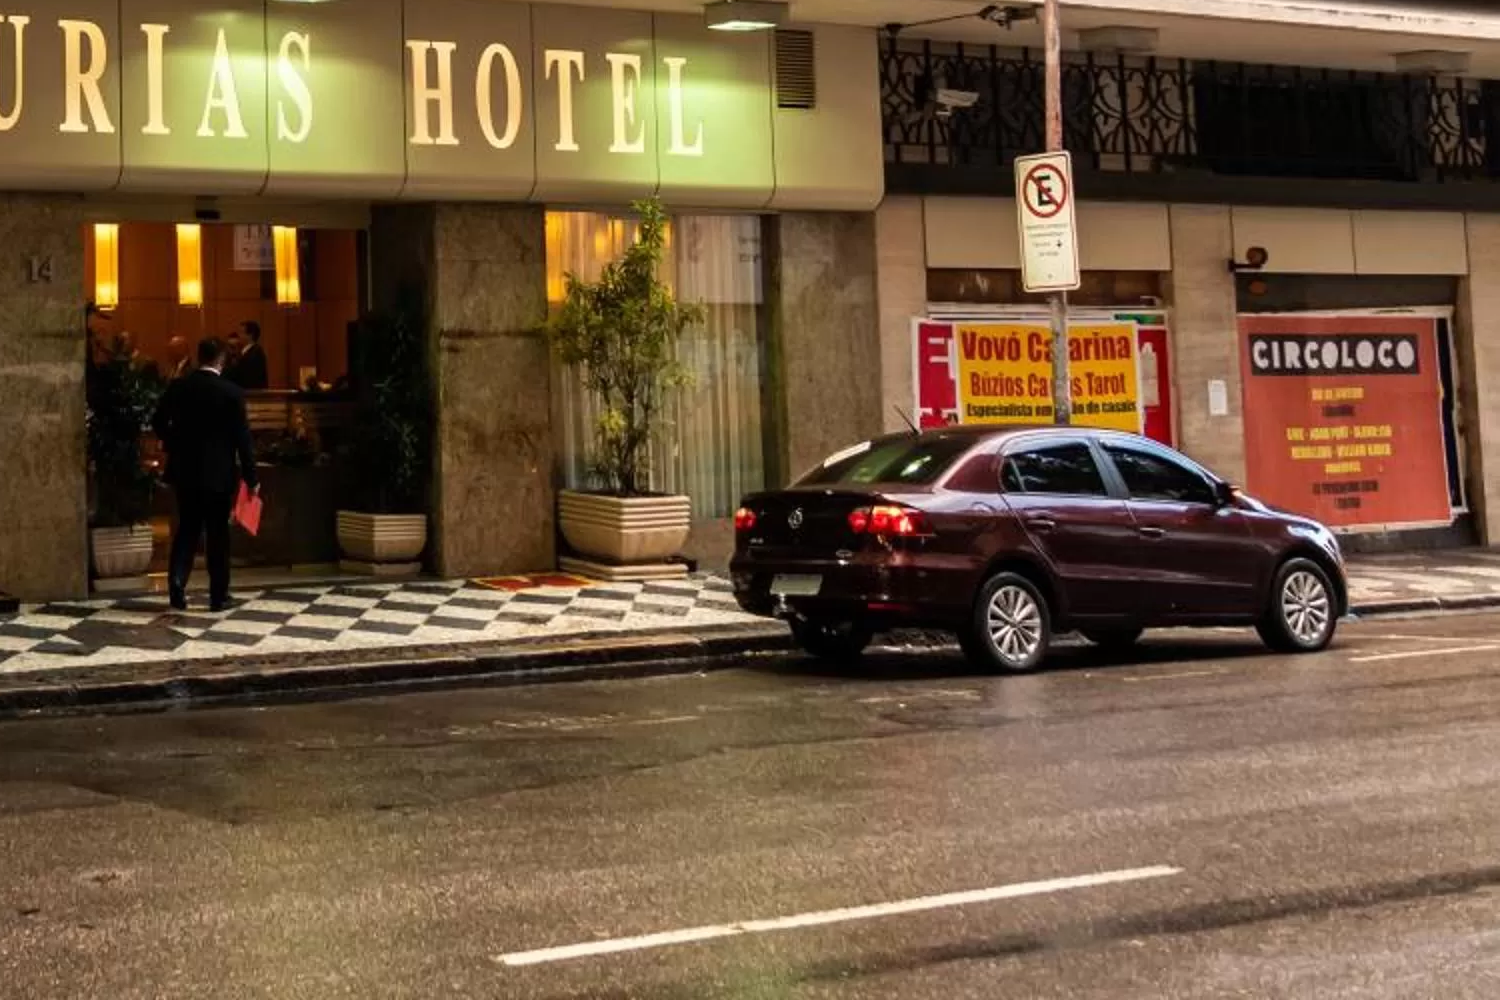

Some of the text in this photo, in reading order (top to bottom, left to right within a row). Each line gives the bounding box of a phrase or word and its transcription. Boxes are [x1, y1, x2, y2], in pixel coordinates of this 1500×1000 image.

[405, 39, 704, 157] HOTEL
[961, 330, 1132, 363] Vovó Caarina
[1252, 339, 1415, 369] CIRCOLOCO
[970, 371, 1126, 397] Búzios Cas Tarot
